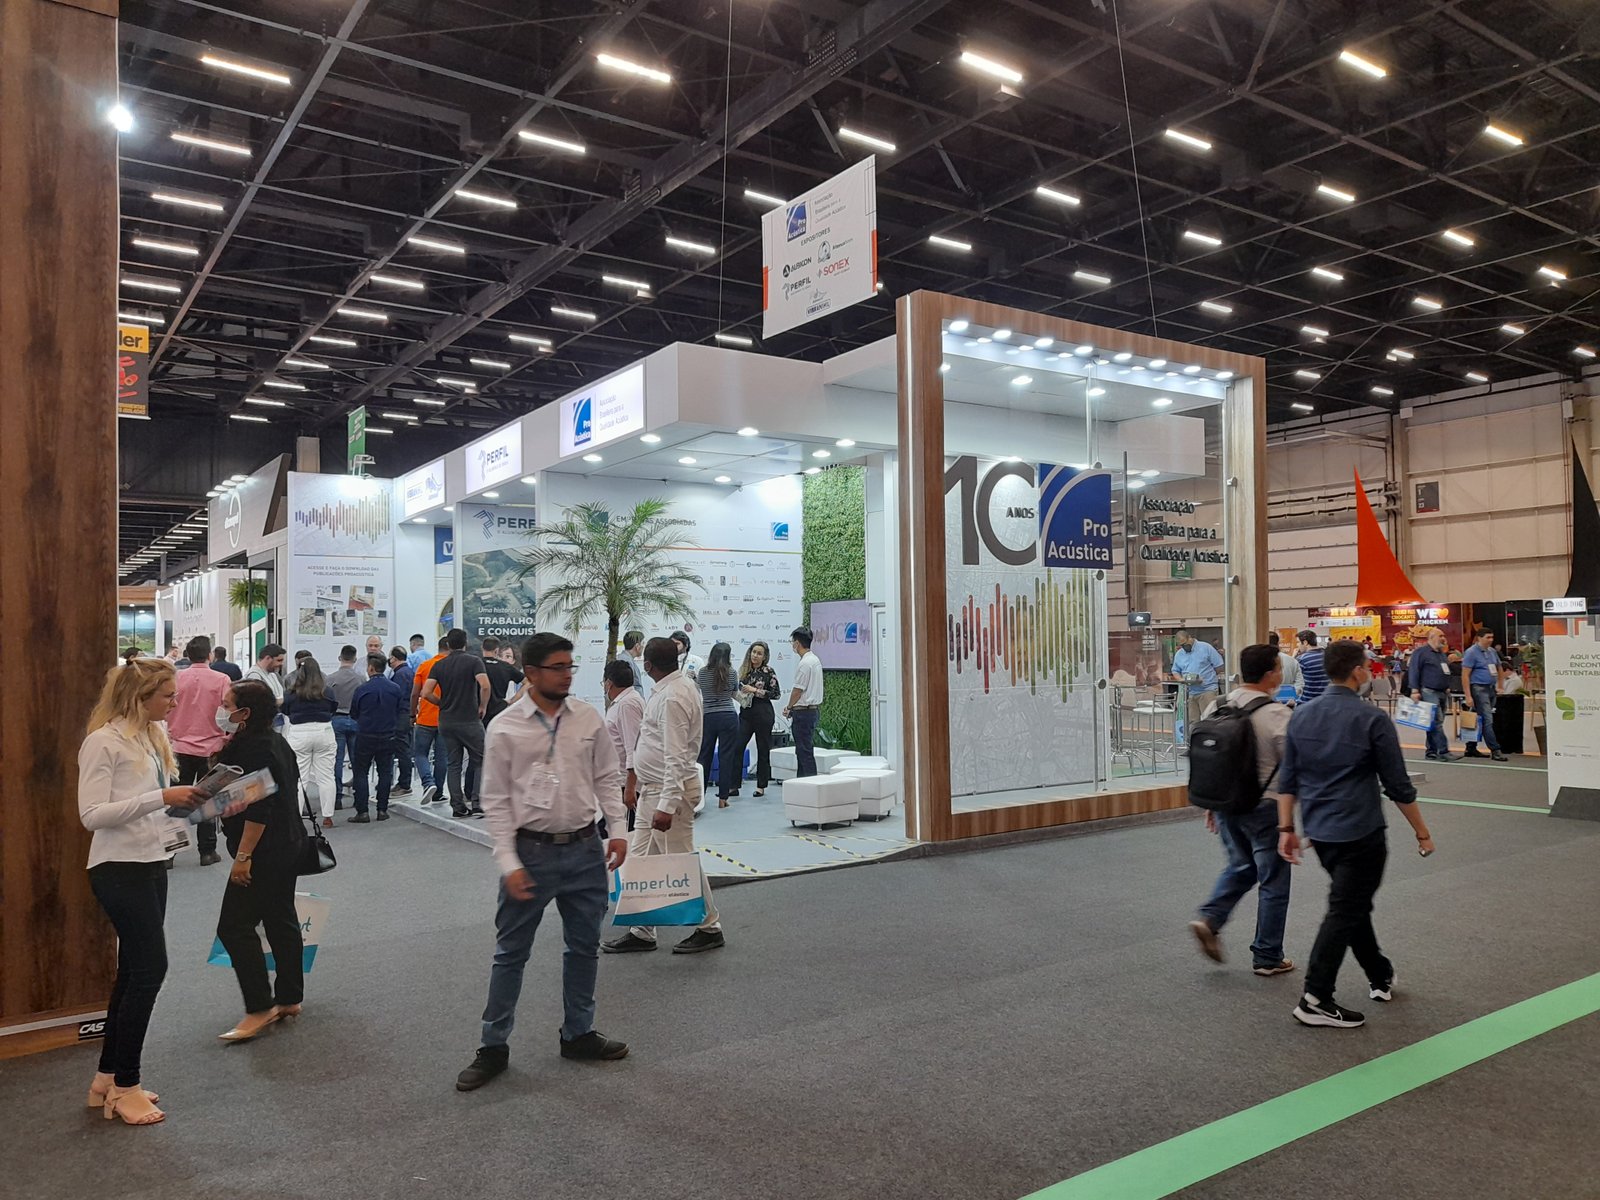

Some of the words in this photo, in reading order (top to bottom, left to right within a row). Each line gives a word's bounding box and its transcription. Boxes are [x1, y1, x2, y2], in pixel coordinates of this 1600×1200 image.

[800, 227, 830, 246] EXPOSITORES
[790, 276, 812, 292] PERFIL
[583, 420, 591, 429] Pro
[487, 445, 509, 466] PERFIL
[1006, 507, 1034, 518] ANOS
[1139, 494, 1195, 516] Associação
[497, 517, 535, 530] PERF
[1084, 518, 1108, 537] Pro
[1140, 520, 1185, 537] Brasileira
[1187, 527, 1208, 541] para
[1210, 528, 1216, 539] a
[1048, 540, 1109, 561] Acústica
[1140, 544, 1190, 561] Qualidade
[1192, 548, 1229, 564] Acústica
[478, 617, 536, 626] TRABALHO,
[1416, 608, 1438, 619] WE
